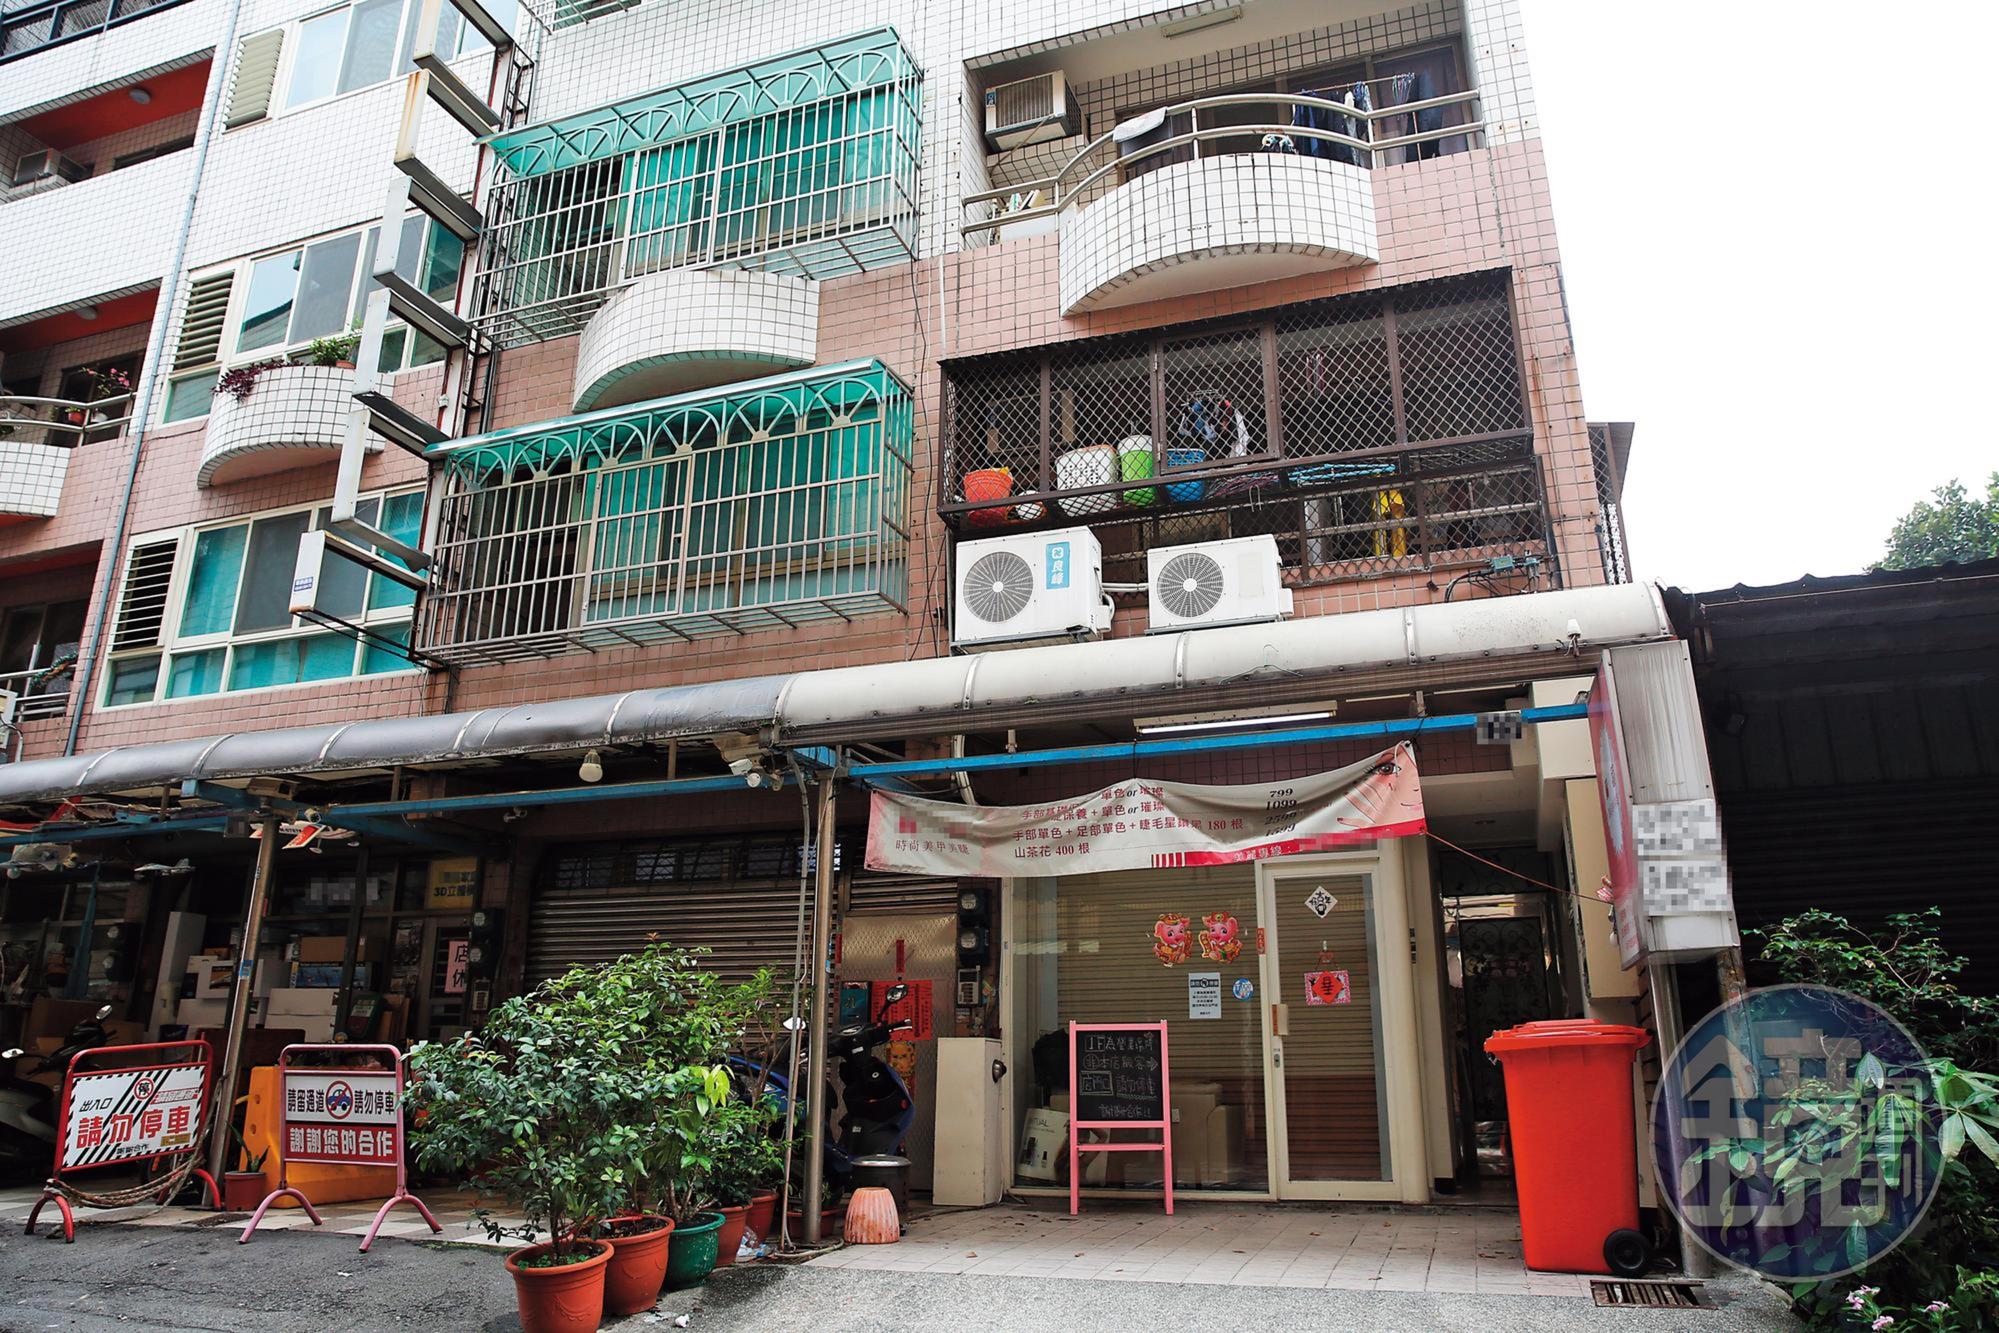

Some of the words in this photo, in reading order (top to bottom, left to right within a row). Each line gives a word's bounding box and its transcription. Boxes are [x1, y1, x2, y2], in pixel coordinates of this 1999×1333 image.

[1051, 560, 1064, 585] 良峰
[1127, 789, 1138, 797] or
[1269, 788, 1294, 797] 799
[1102, 804, 1126, 817] 單色
[1127, 806, 1139, 814] or
[1265, 800, 1297, 811] 1099
[1013, 827, 1063, 841] 手部單色
[1077, 822, 1127, 837] 足部單色
[1208, 820, 1226, 831] 180
[1231, 818, 1244, 830] 根
[1014, 845, 1052, 859] 山茶花
[1055, 846, 1074, 857] 400
[1078, 842, 1090, 854] 根
[79, 1097, 113, 1112] 出入口
[288, 1089, 325, 1113] 請留通道
[354, 1089, 395, 1115] 請勿停車
[76, 1106, 191, 1149] 請勿停車
[289, 1127, 393, 1157] 謝謝您的合作
